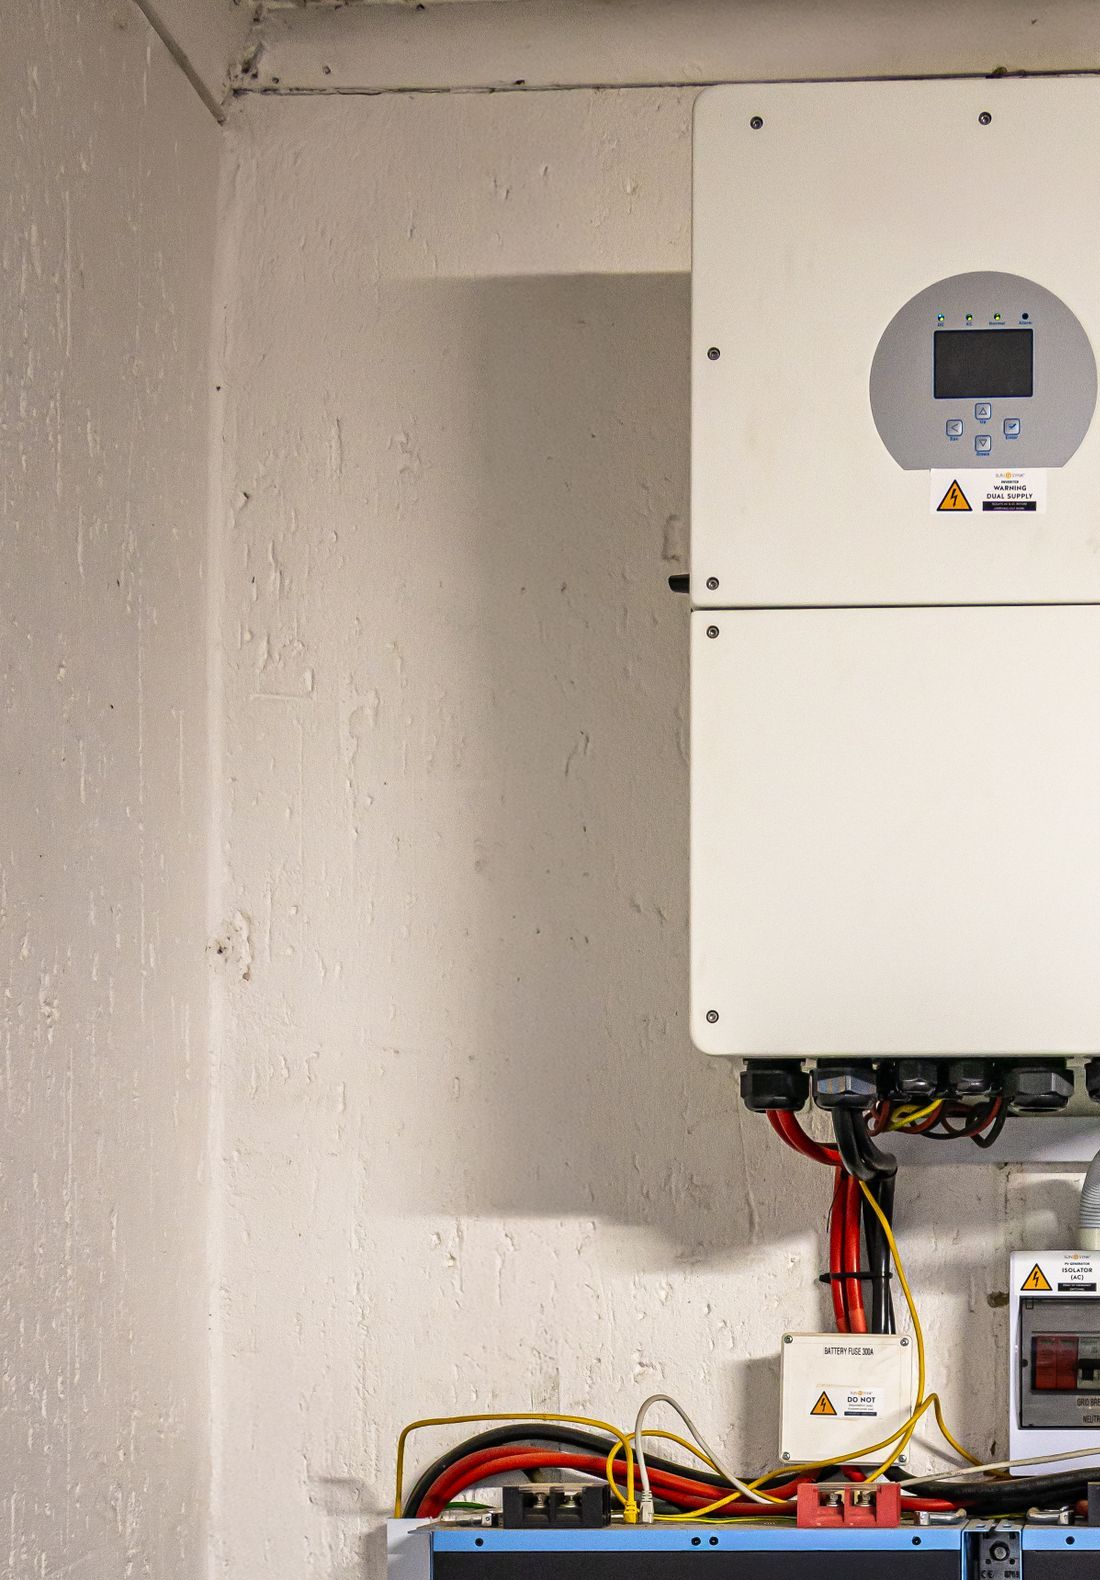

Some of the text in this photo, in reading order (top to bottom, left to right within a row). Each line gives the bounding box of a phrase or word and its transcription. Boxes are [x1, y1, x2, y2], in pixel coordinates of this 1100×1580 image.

[824, 1347, 874, 1355] BATTERY FUSE 300A
[1076, 1398, 1089, 1406] GRID
